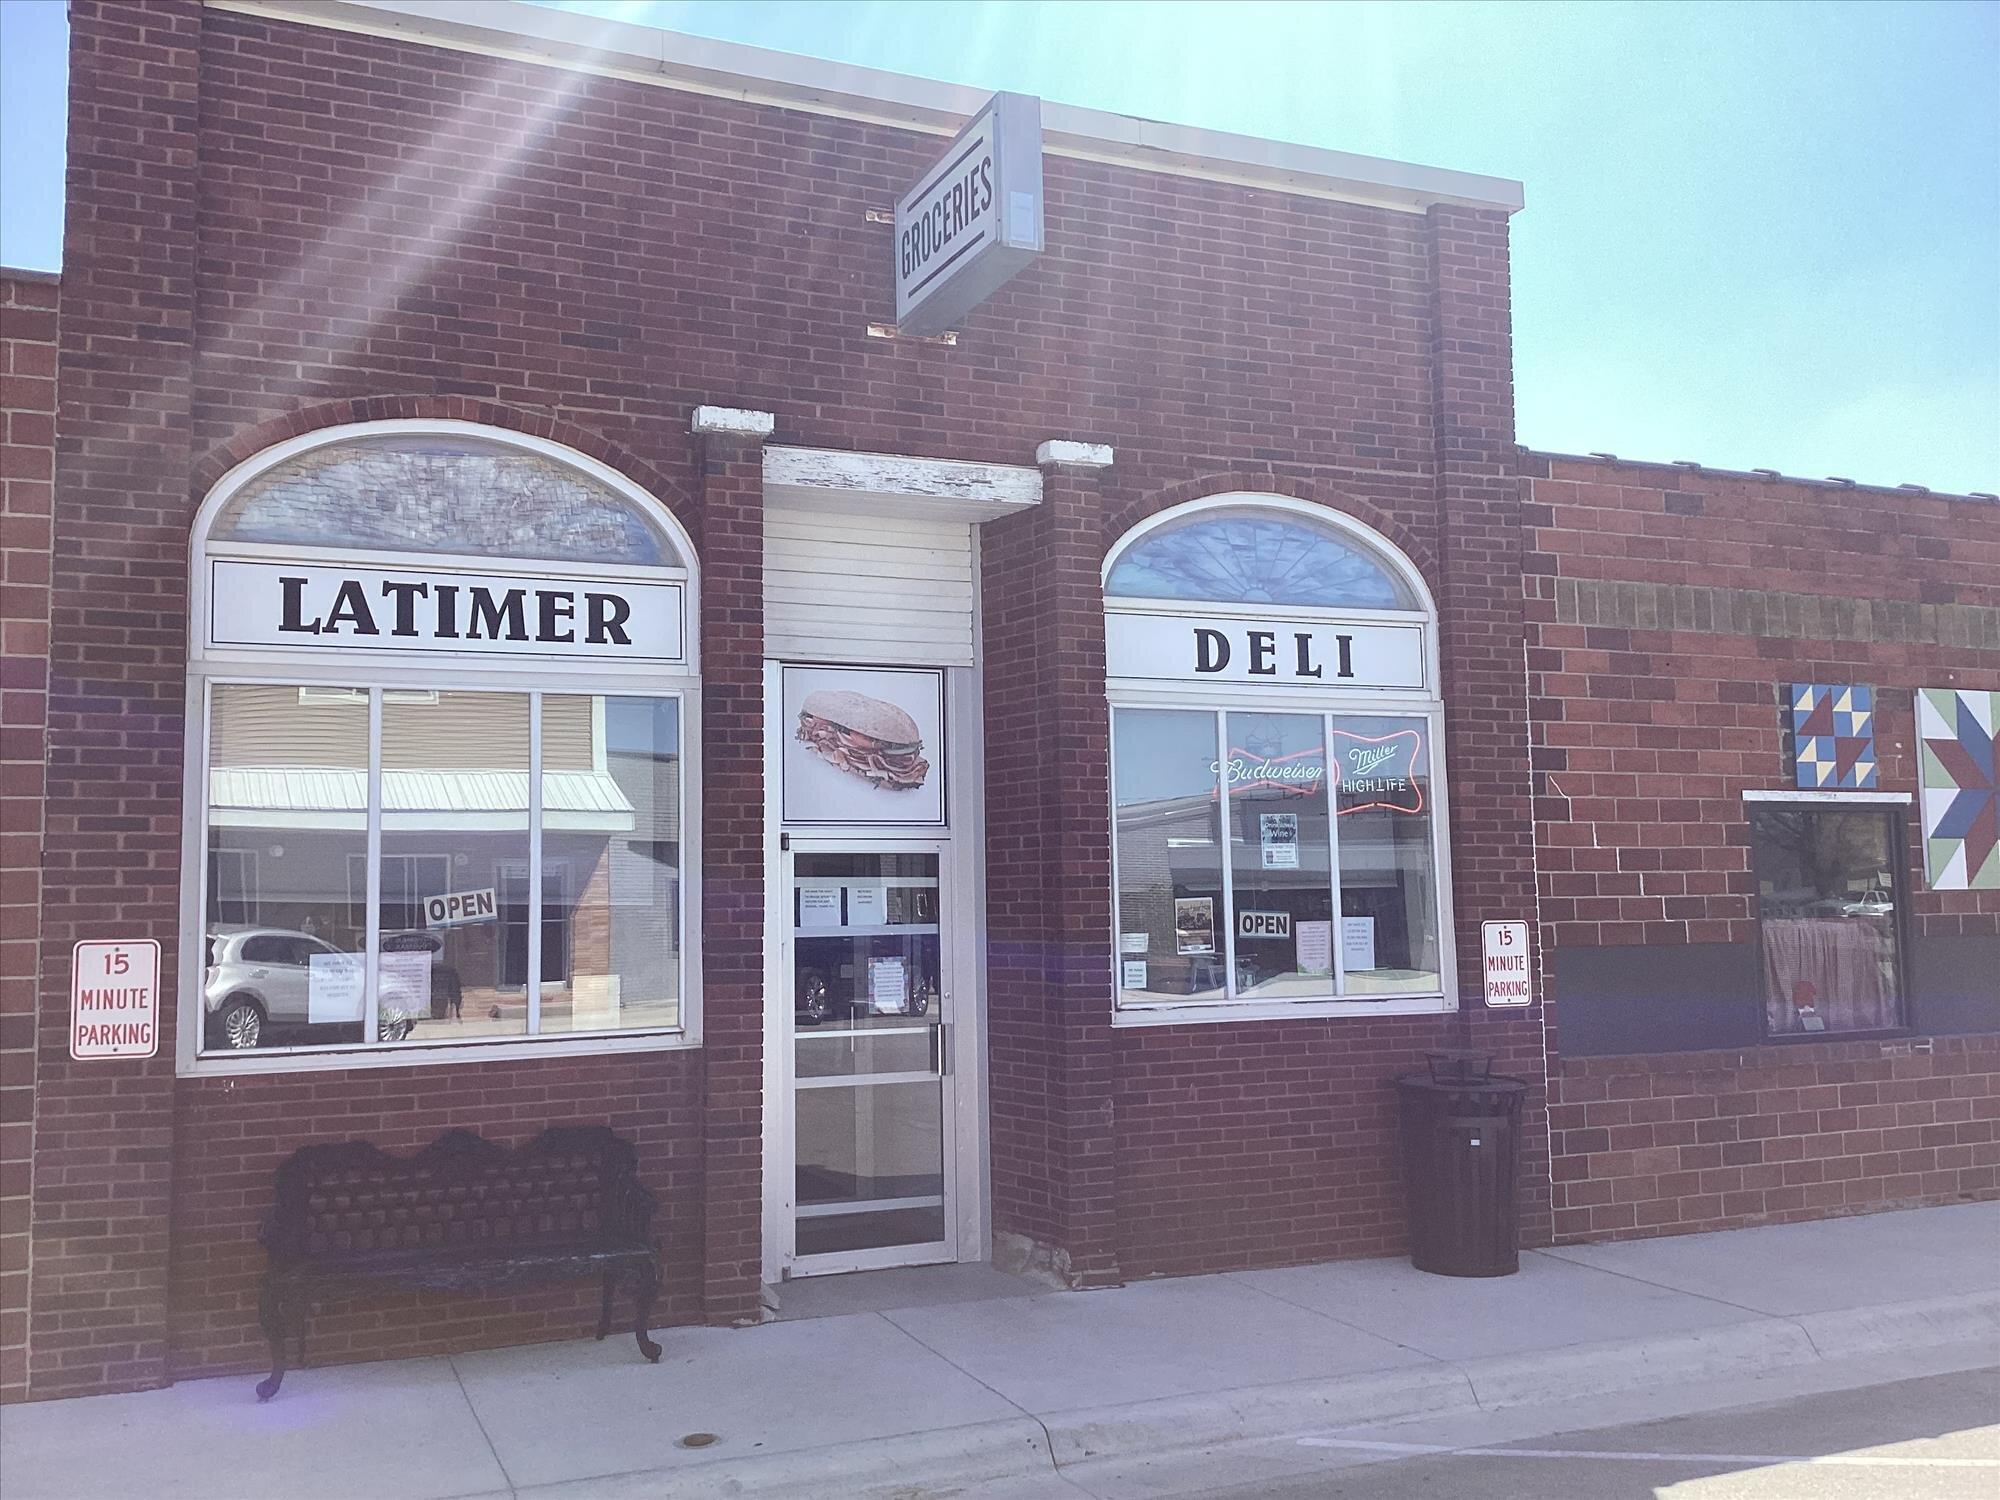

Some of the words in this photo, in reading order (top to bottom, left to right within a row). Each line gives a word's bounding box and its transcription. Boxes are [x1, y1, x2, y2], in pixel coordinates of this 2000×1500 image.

[902, 156, 992, 280] GROCERIES
[278, 577, 632, 645] LATIMER
[1193, 628, 1354, 678] DELI
[1210, 758, 1326, 783] Budweiser
[1349, 745, 1398, 774] Miller
[1342, 779, 1374, 793] HIGH
[1375, 777, 1407, 792] LIFE
[429, 892, 493, 921] OPEN
[1242, 915, 1287, 934] OPEN
[1498, 930, 1513, 946] 15
[104, 953, 130, 975] 15
[1488, 955, 1525, 972] MINUTE
[80, 988, 148, 1010] MINUTE
[1488, 981, 1528, 997] PARKING
[78, 1023, 151, 1046] PARKING
